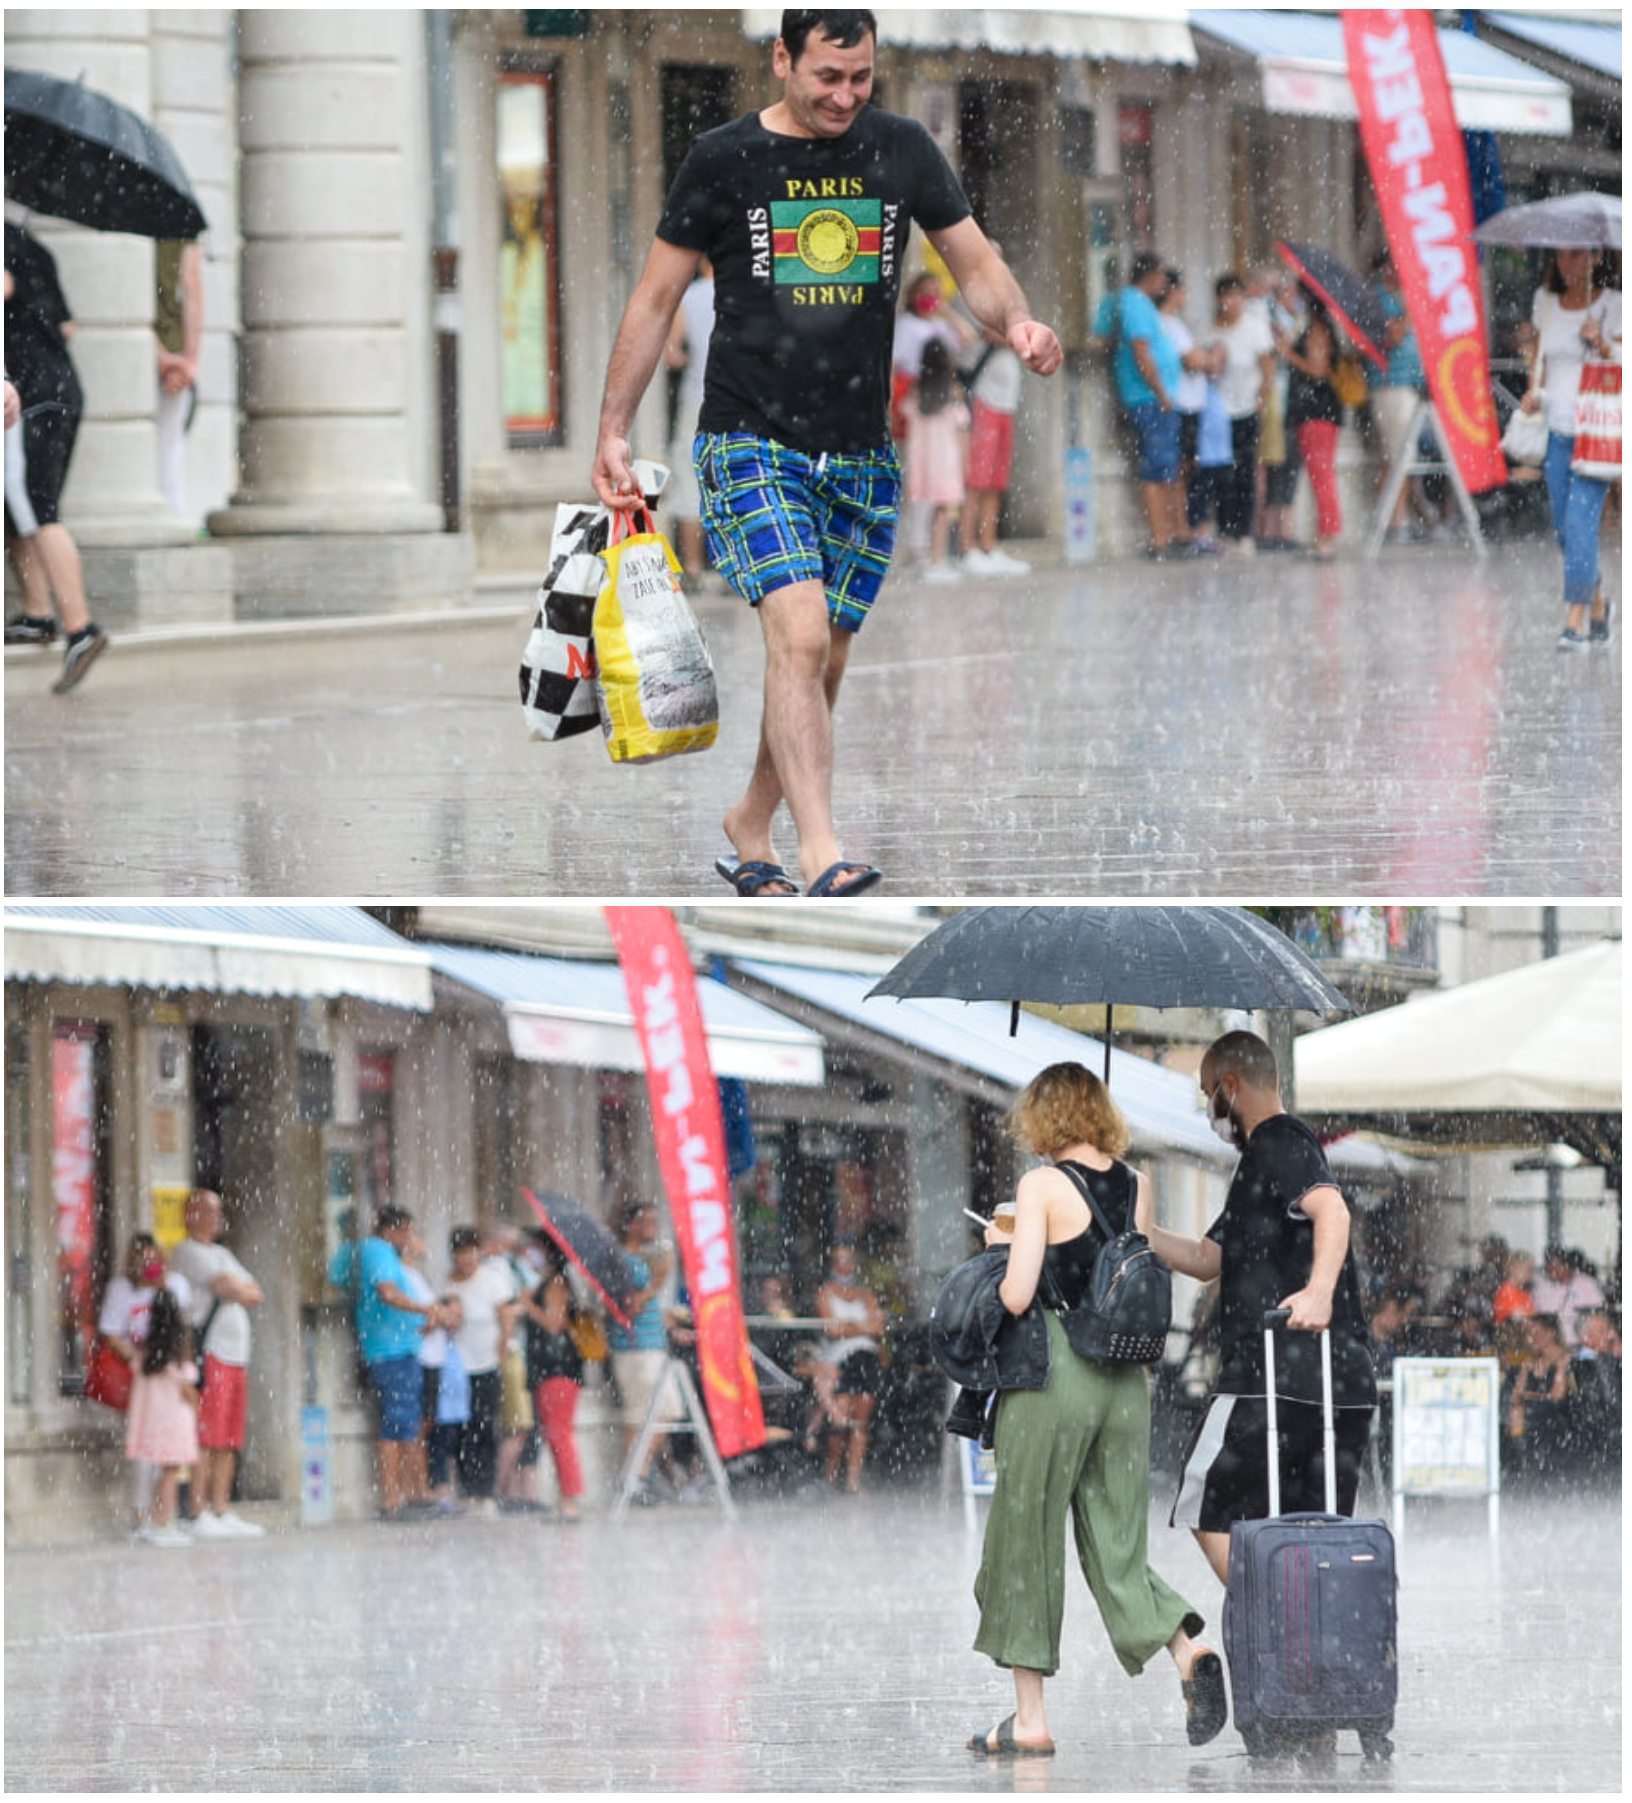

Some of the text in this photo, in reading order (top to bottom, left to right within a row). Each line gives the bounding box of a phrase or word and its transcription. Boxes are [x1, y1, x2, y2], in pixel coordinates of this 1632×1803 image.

[785, 176, 864, 199] PARIS
[747, 207, 770, 278] PARIS
[882, 203, 898, 278] PARIS
[793, 285, 864, 306] PARIS
